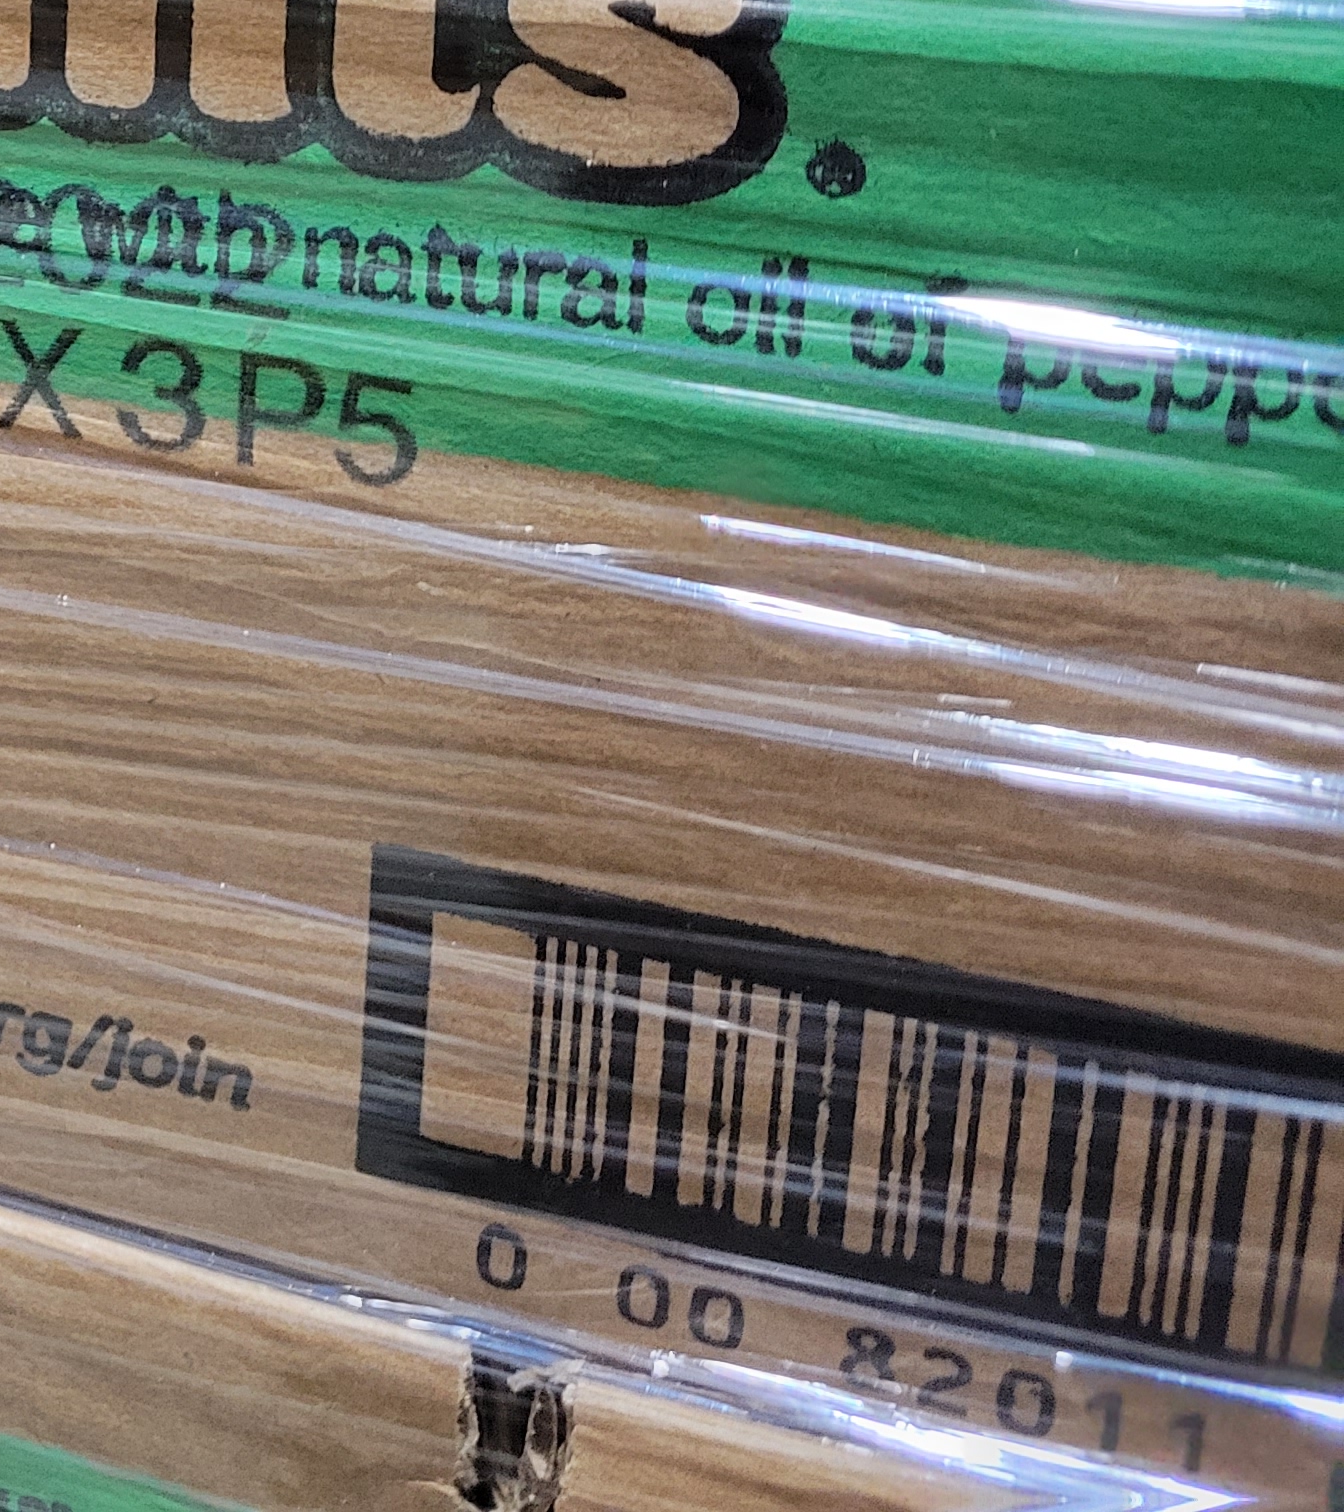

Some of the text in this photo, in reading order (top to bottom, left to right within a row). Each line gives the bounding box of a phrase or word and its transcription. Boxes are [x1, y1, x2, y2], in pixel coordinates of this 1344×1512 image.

[302, 220, 650, 335] natural
[997, 306, 1344, 447] pepp
[476, 1223, 1210, 1475] 0 00 82011
